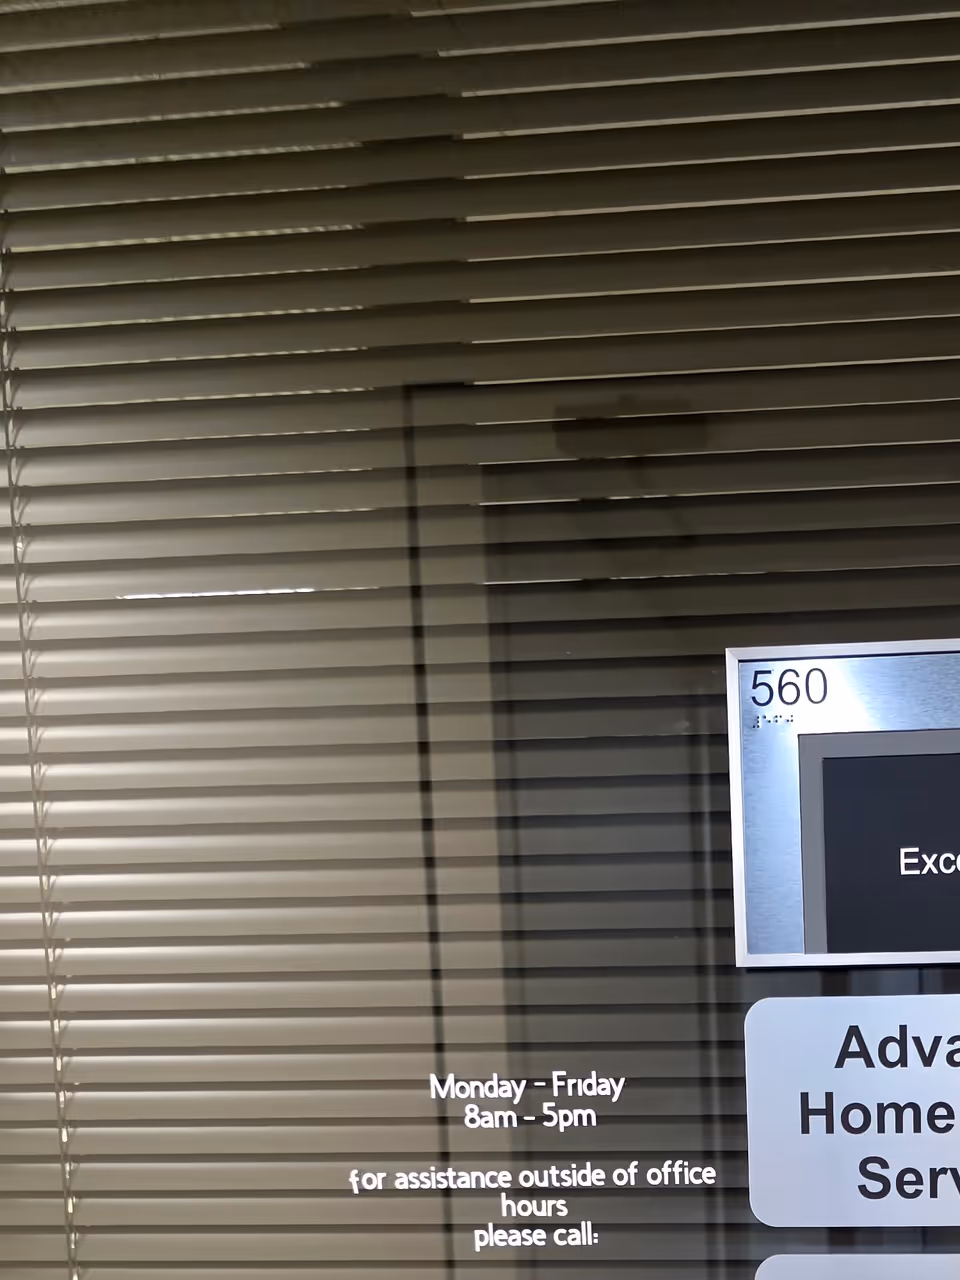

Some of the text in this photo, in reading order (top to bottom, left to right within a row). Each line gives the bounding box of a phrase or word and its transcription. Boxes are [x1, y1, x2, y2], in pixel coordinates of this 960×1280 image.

[751, 667, 828, 707] 560
[429, 1072, 527, 1106] Monday
[464, 1103, 518, 1129] 8am
[542, 1101, 597, 1133] 5pm
[800, 1091, 956, 1135] Home
[348, 1159, 717, 1195] for assistance outside of office
[500, 1192, 569, 1217] hours
[474, 1220, 599, 1253] please call:
